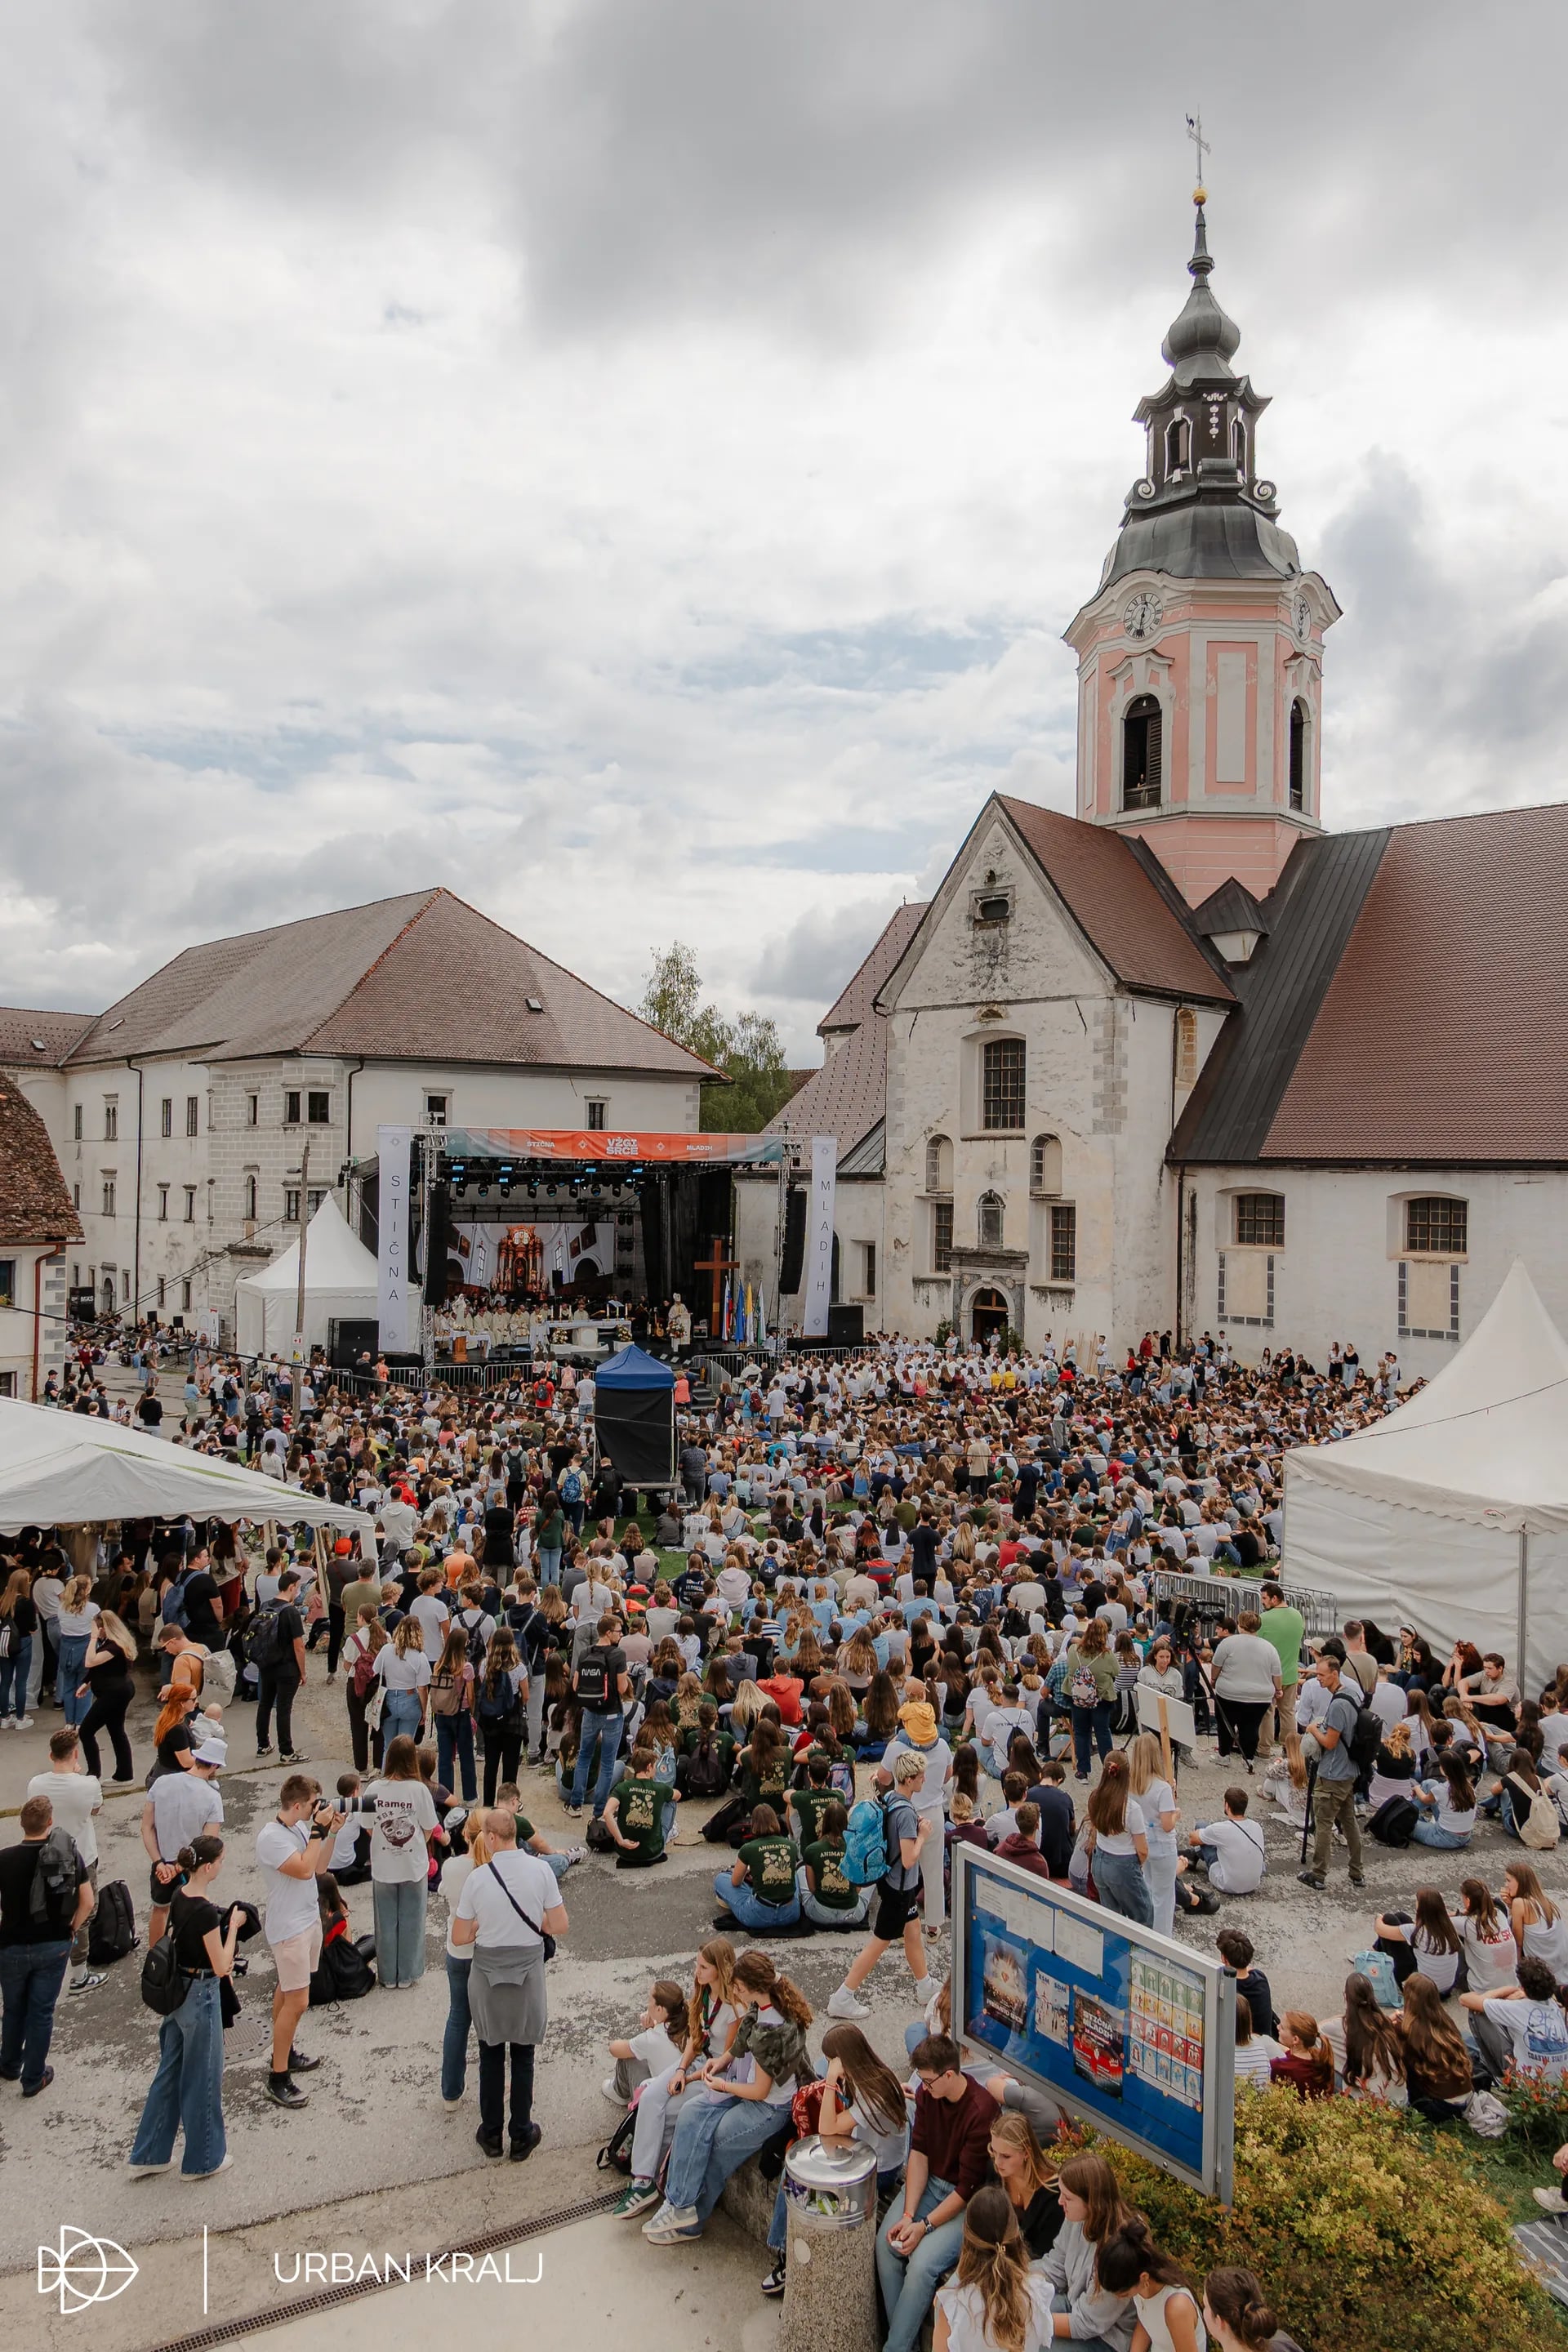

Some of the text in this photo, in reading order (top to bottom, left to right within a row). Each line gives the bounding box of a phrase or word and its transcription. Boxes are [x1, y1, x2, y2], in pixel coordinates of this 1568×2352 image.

[607, 1136, 637, 1147] VŽGI
[606, 1147, 639, 1155] SRCE
[388, 1175, 400, 1300] STIČNA
[817, 1180, 831, 1291] MLADIH
[581, 1668, 601, 1677] NASA
[629, 1787, 656, 1795] ANIMATOR
[377, 1800, 412, 1809] Ramen
[810, 1797, 838, 1805] ANIMATOR
[758, 1843, 791, 1852] ANIMATOR
[1083, 2011, 1113, 2033] STIČNA
[1083, 2018, 1113, 2040] MLADIH
